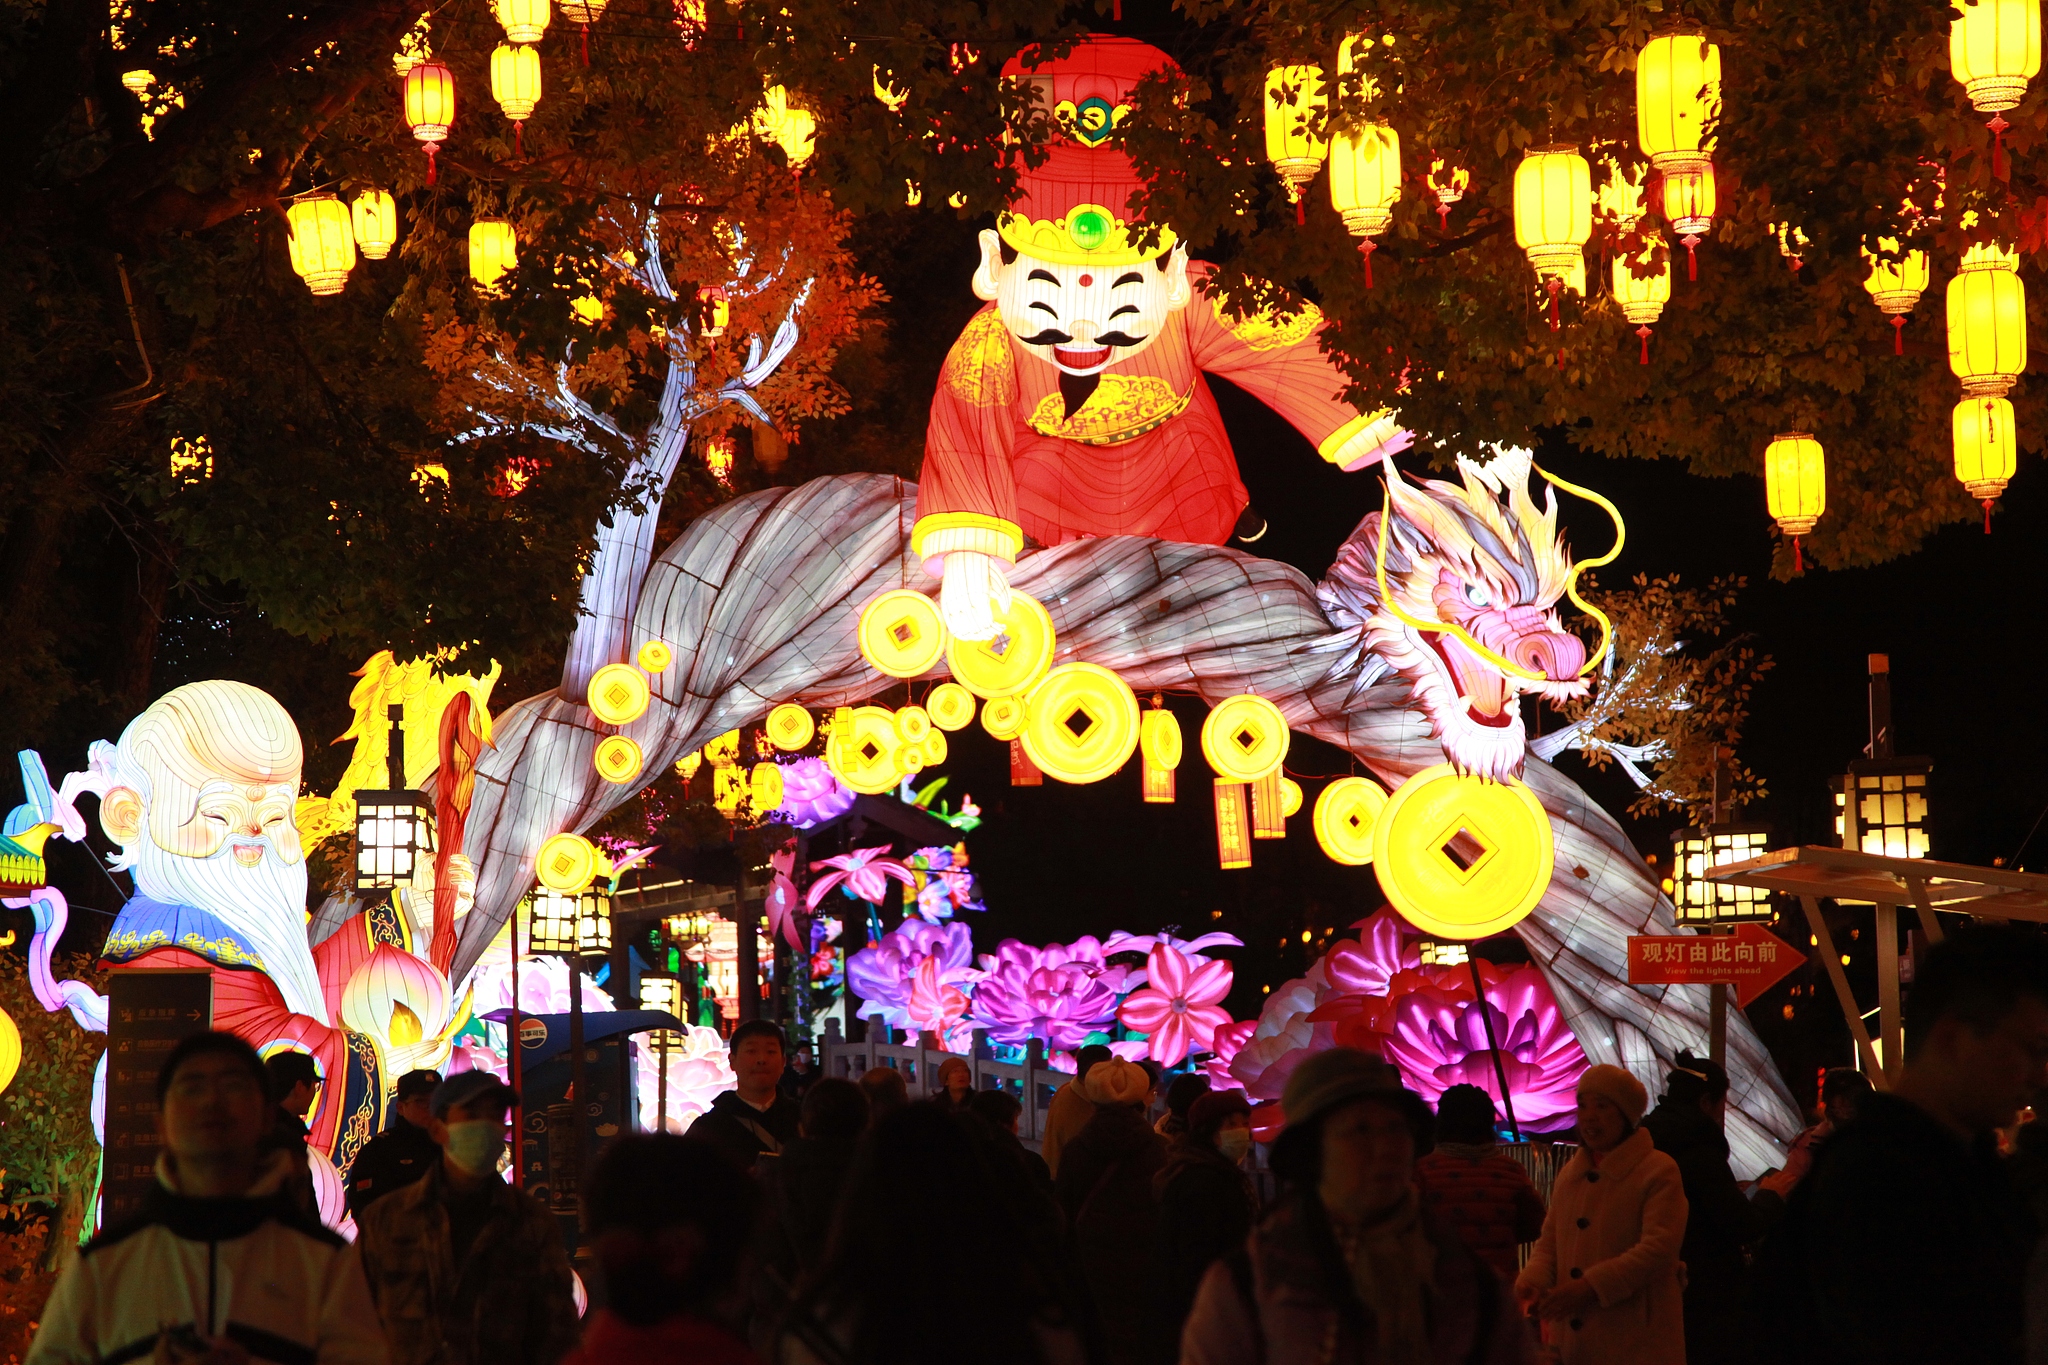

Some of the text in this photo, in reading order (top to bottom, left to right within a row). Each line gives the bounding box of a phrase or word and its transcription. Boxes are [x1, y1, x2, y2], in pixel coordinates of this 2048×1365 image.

[1642, 942, 1777, 963] 观灯由此向前
[1689, 966, 1704, 974] the
[1706, 966, 1732, 976] lights
[1734, 966, 1761, 974] ahead
